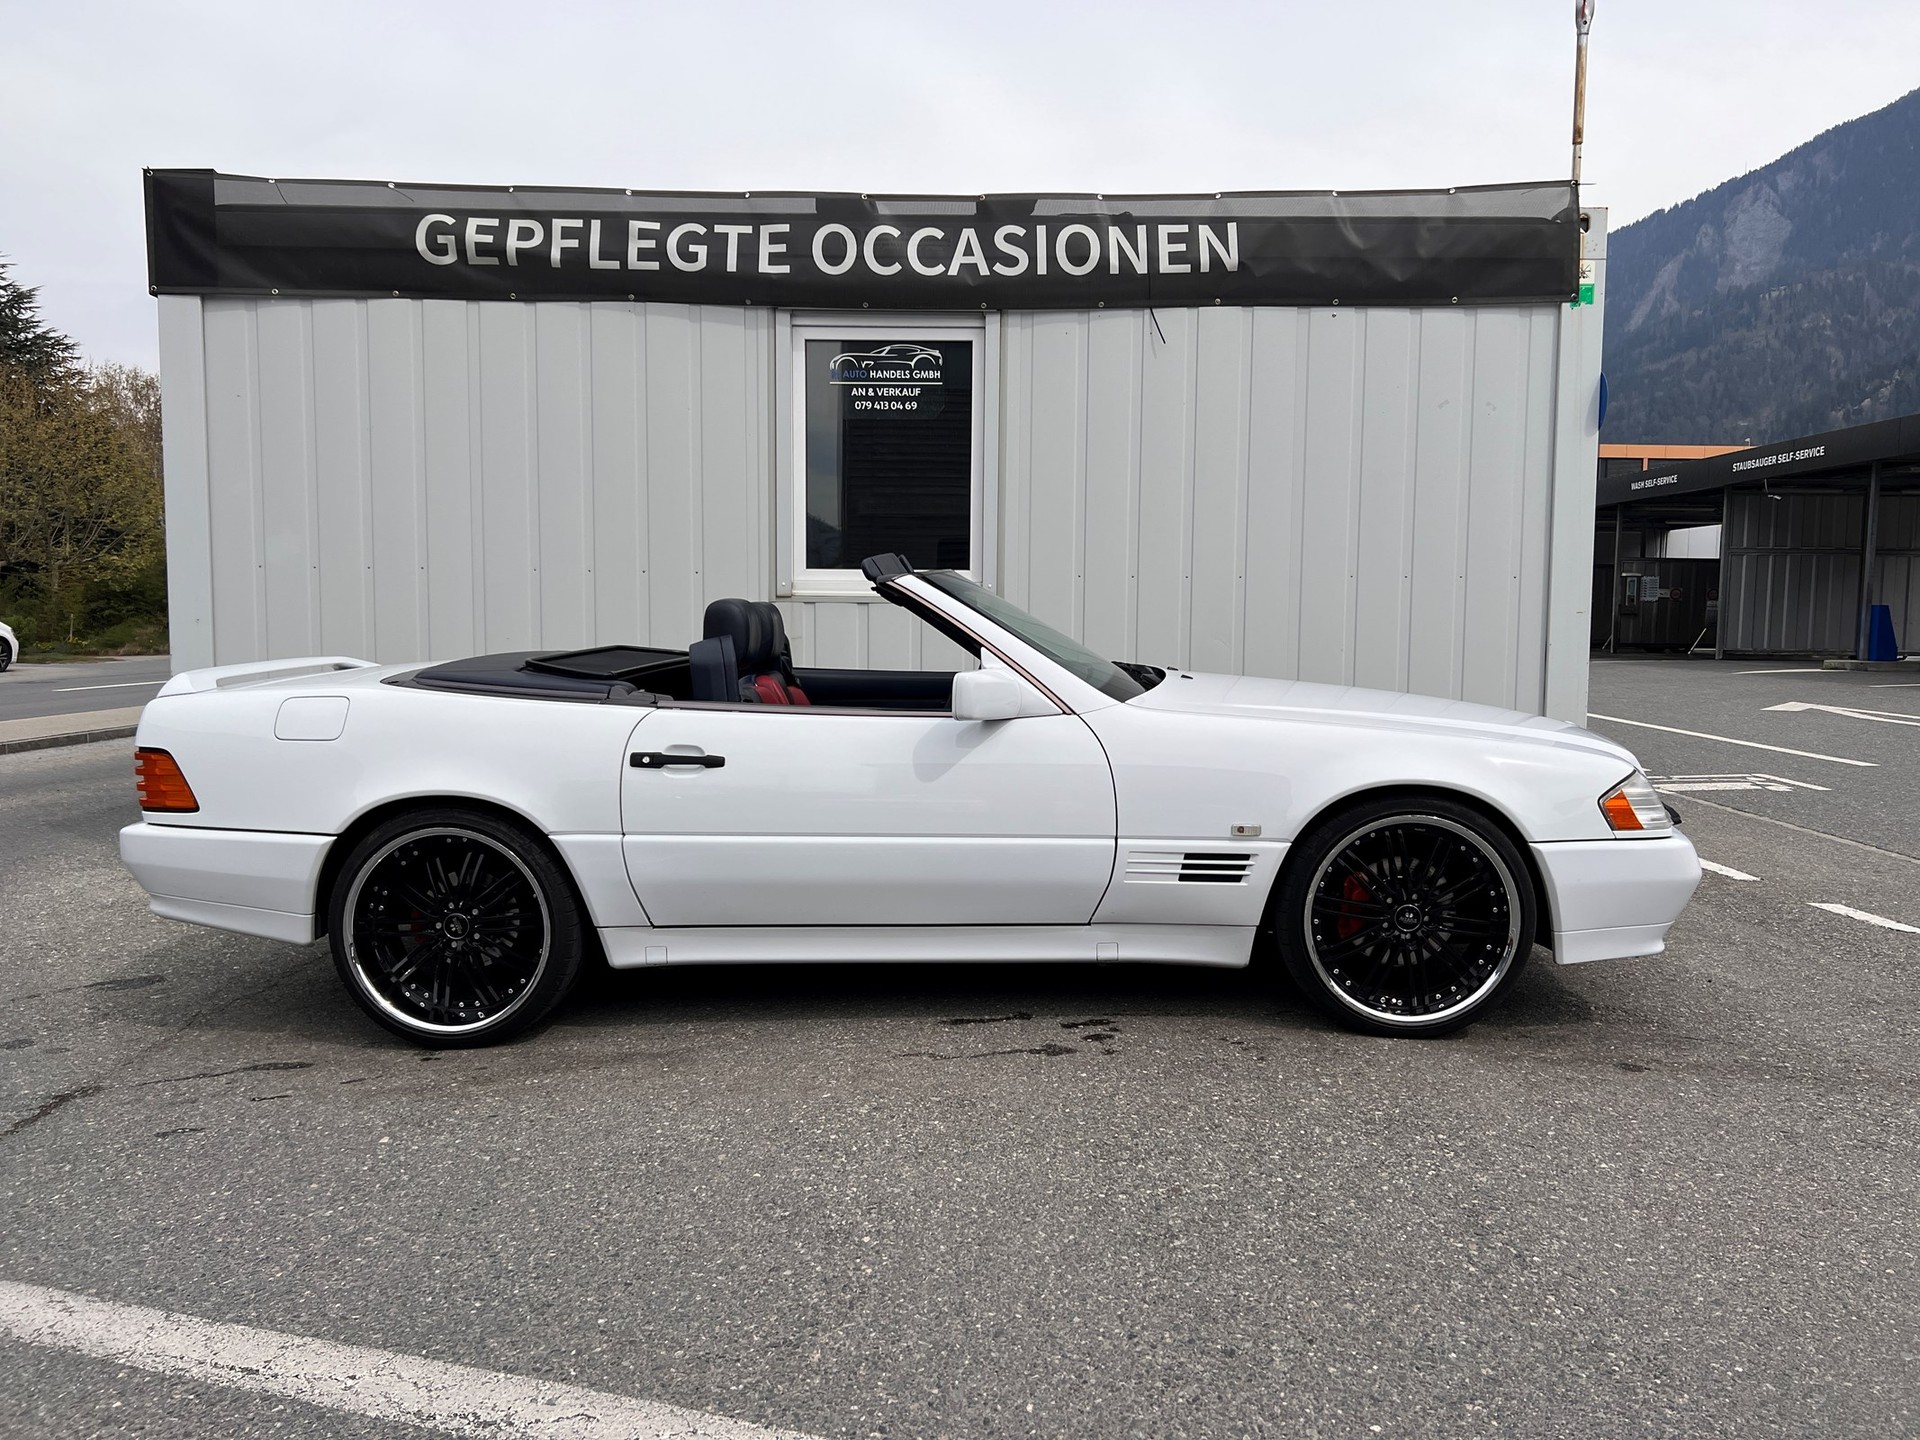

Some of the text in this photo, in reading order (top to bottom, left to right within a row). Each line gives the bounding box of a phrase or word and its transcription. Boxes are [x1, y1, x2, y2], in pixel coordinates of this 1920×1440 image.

[415, 213, 1239, 277] GEPFLEGTE OCCASIONEN
[843, 370, 867, 379] AUTO
[869, 370, 910, 379] HANDELS
[912, 370, 941, 379] GMBH
[851, 387, 921, 397] AN & VERKAUF
[854, 401, 918, 410] 079 413 04 69
[1732, 445, 1825, 472] STAUBSAUGER SELF-SERVICE
[1631, 474, 1678, 490] WASH SELF-SERVICE
